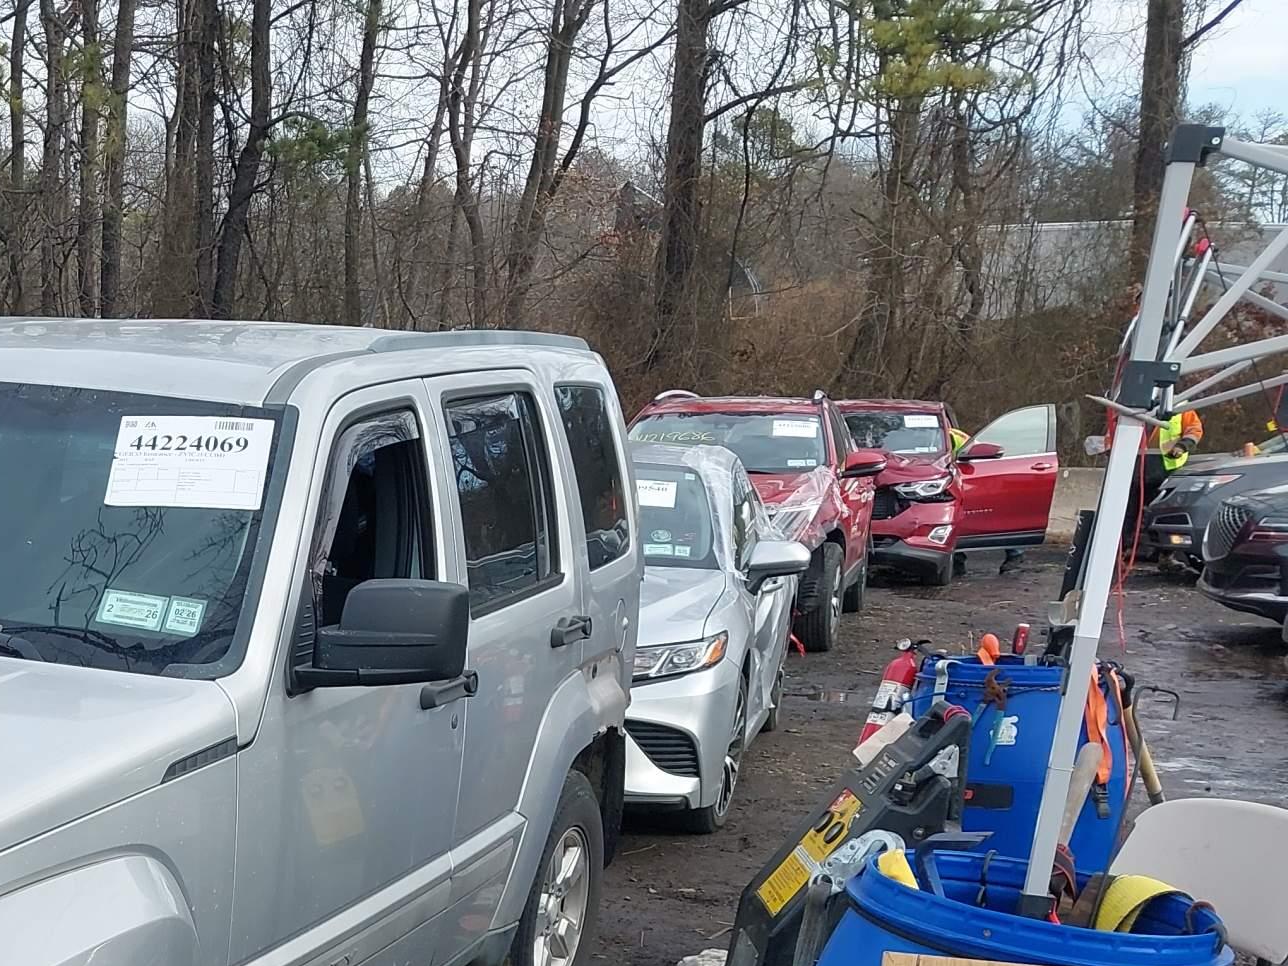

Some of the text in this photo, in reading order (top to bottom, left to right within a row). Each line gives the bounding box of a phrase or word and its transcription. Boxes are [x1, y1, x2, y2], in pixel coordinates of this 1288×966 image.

[129, 434, 249, 453] 44224069
[106, 603, 159, 620] 2 26
